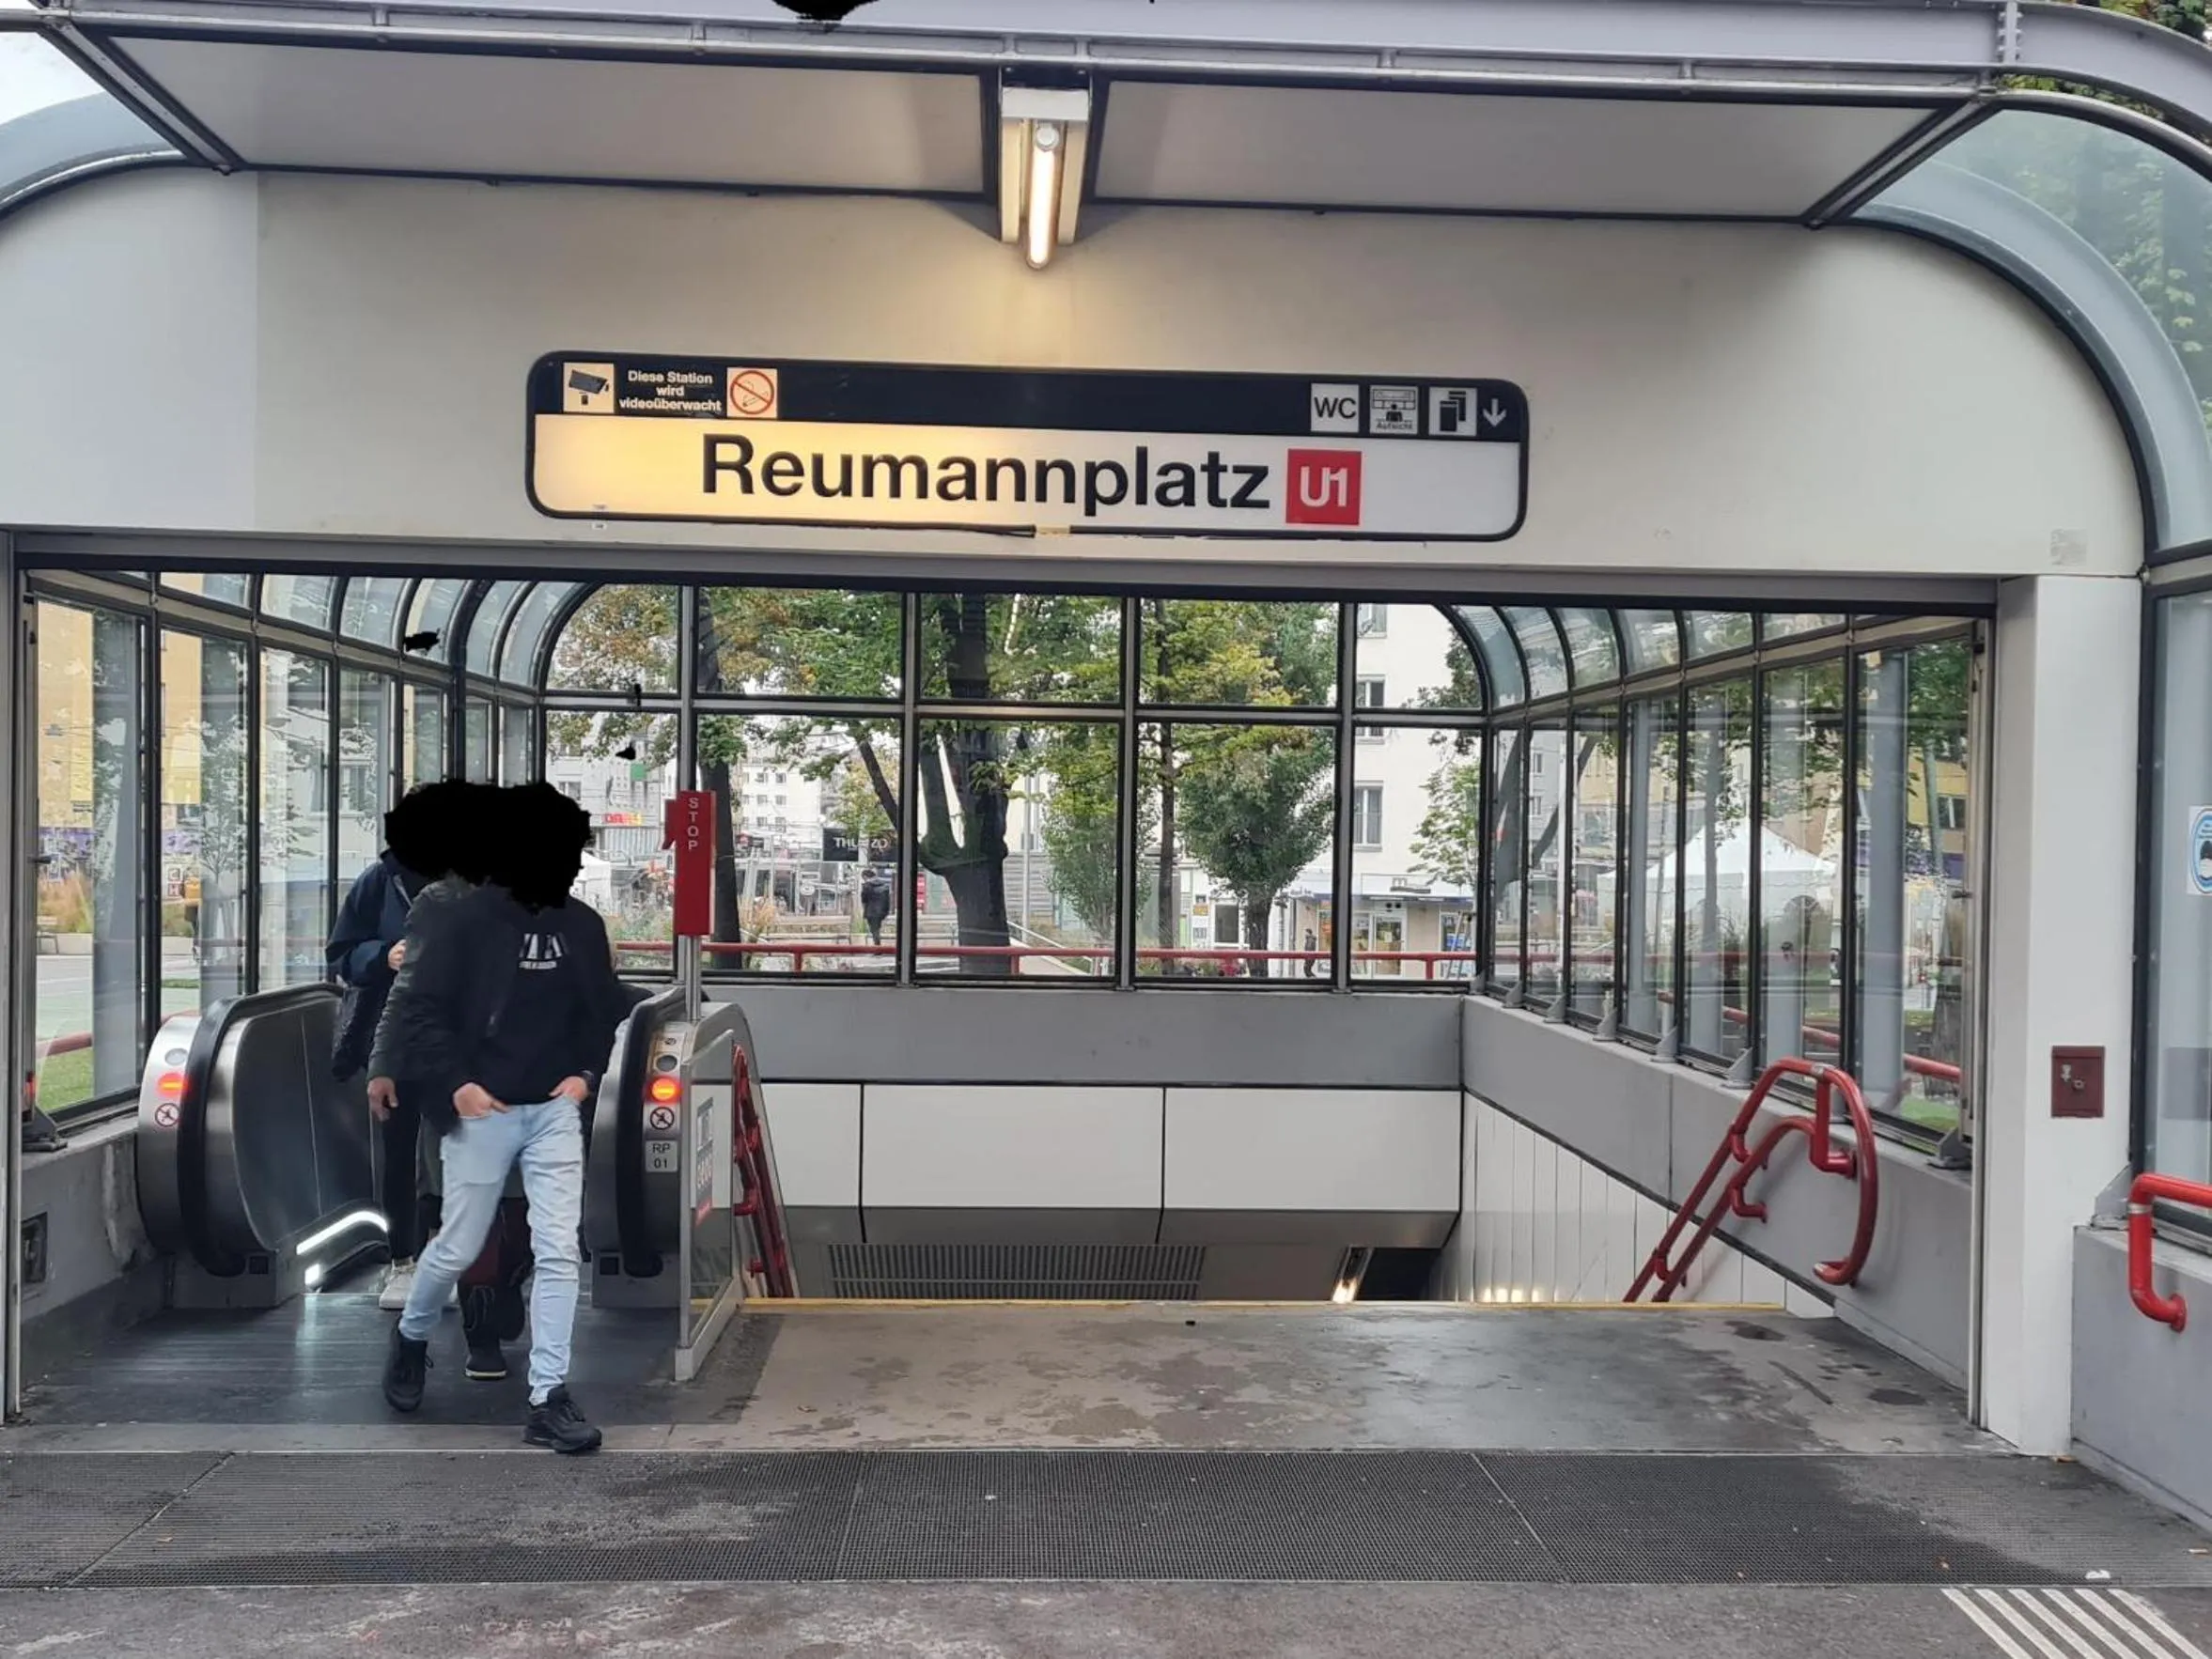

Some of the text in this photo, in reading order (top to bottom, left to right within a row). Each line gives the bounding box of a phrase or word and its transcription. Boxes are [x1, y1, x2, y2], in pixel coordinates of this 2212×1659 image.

[628, 370, 712, 384] Diese Station
[656, 385, 684, 396] wird
[619, 398, 722, 411] videoüberwacht
[1314, 396, 1356, 419] WC
[702, 433, 1347, 516] Reumannplatz U1
[687, 797, 699, 850] STOP
[652, 1142, 670, 1154] RP
[654, 1157, 667, 1169] 01
